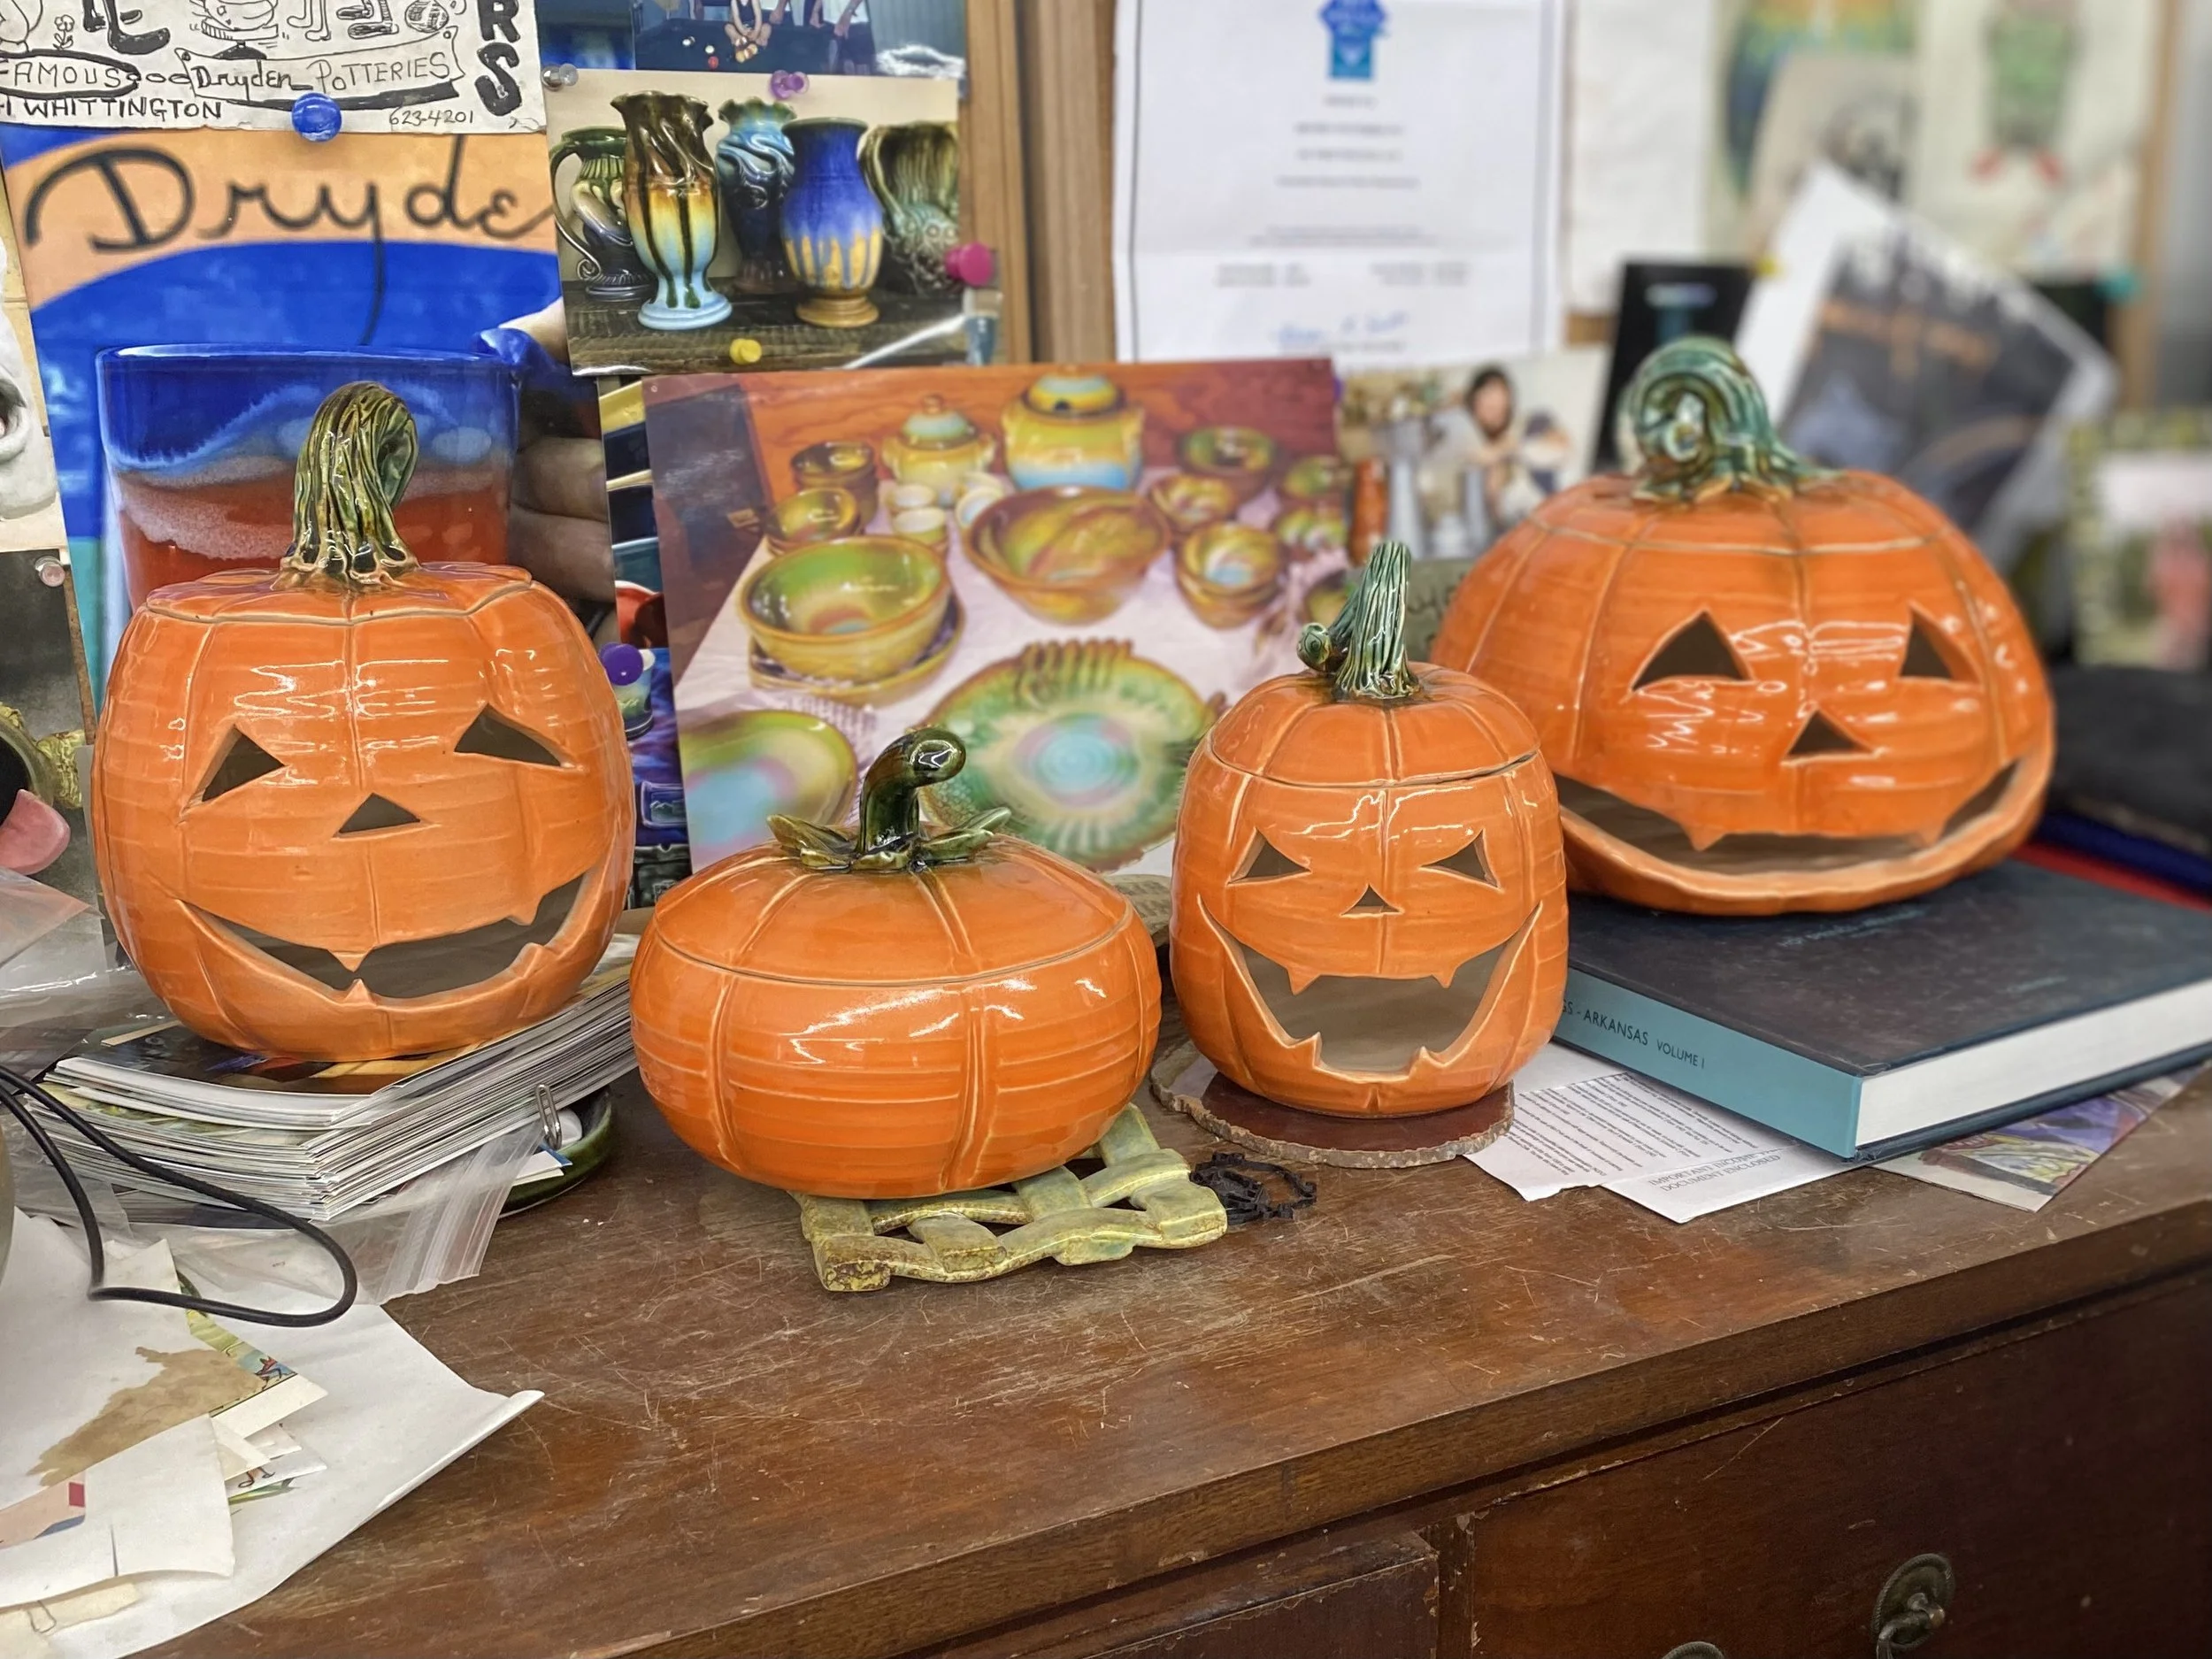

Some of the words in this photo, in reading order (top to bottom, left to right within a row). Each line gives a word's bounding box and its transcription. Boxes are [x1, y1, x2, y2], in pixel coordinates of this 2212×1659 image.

[24, 96, 222, 121] WHITTINGTON
[389, 109, 473, 126] 623-4201
[1584, 1010, 1648, 1046] ARKANSAS
[1657, 1039, 1698, 1067] VOLUME
[1648, 1163, 1713, 1186] IMPORTANT
[1660, 1170, 1724, 1192] DOCUMENT
[1722, 1155, 1781, 1175] ENCLOSED
